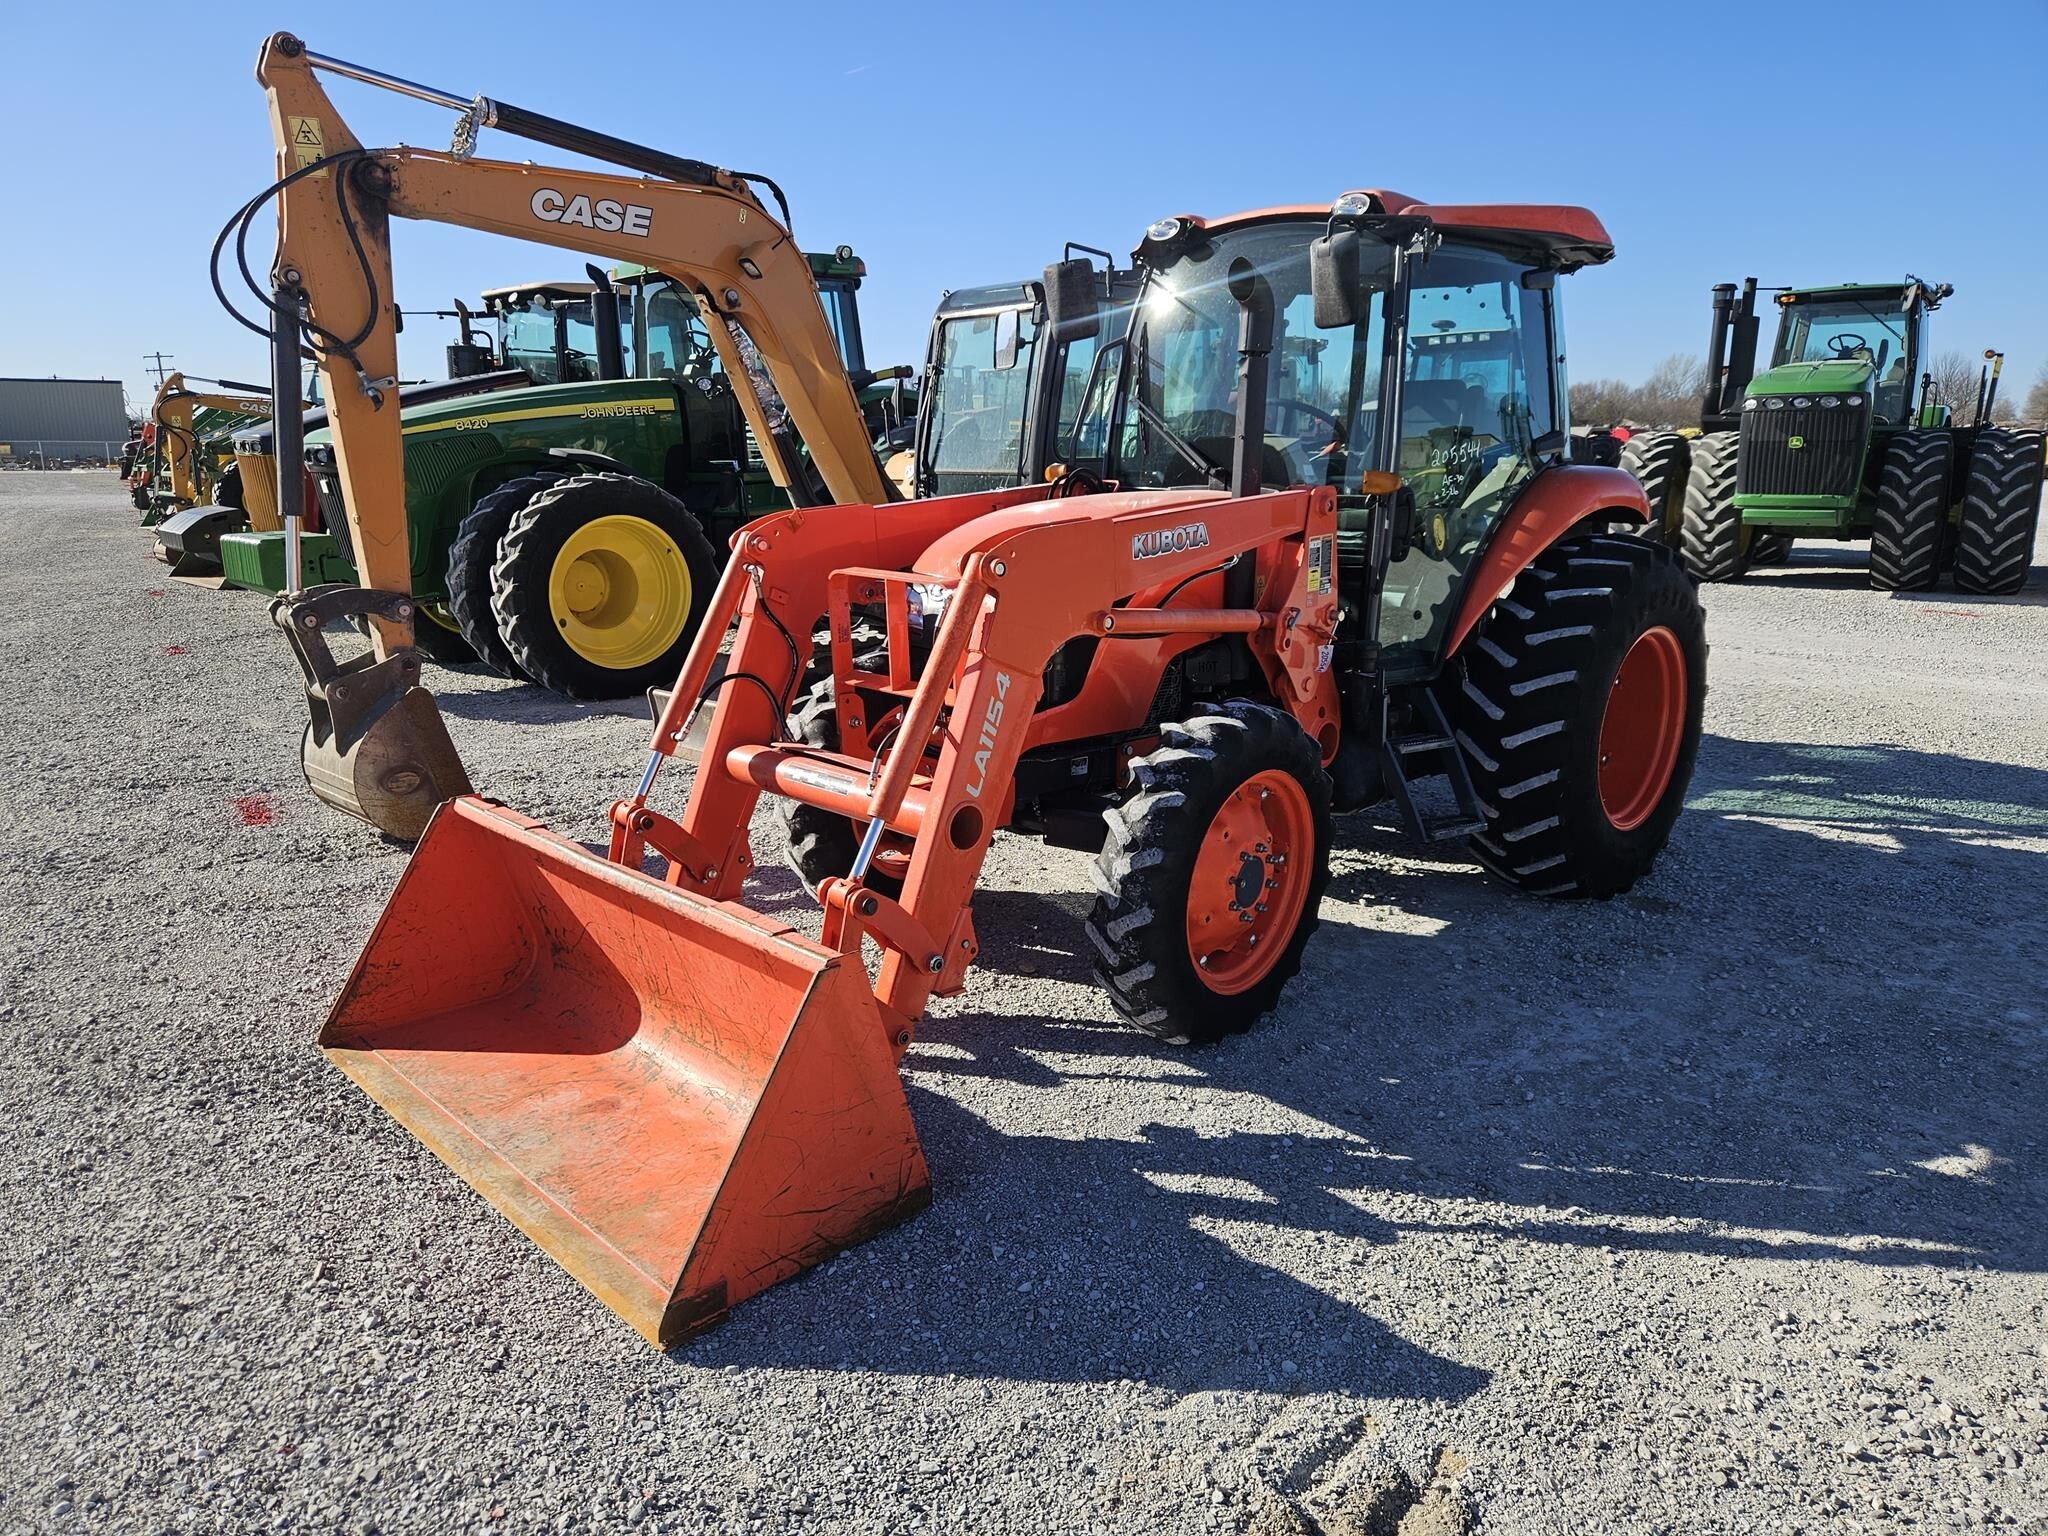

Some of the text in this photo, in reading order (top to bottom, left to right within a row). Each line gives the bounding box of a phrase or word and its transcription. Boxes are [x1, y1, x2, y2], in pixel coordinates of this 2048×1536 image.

[530, 188, 653, 237] CASE
[240, 401, 272, 414] CAS
[580, 405, 656, 419] JOHN DEERE
[455, 418, 488, 431] 8420
[1431, 440, 1481, 467] 205544
[1132, 523, 1209, 560] KUBOTA
[965, 671, 1011, 798] LA1154
